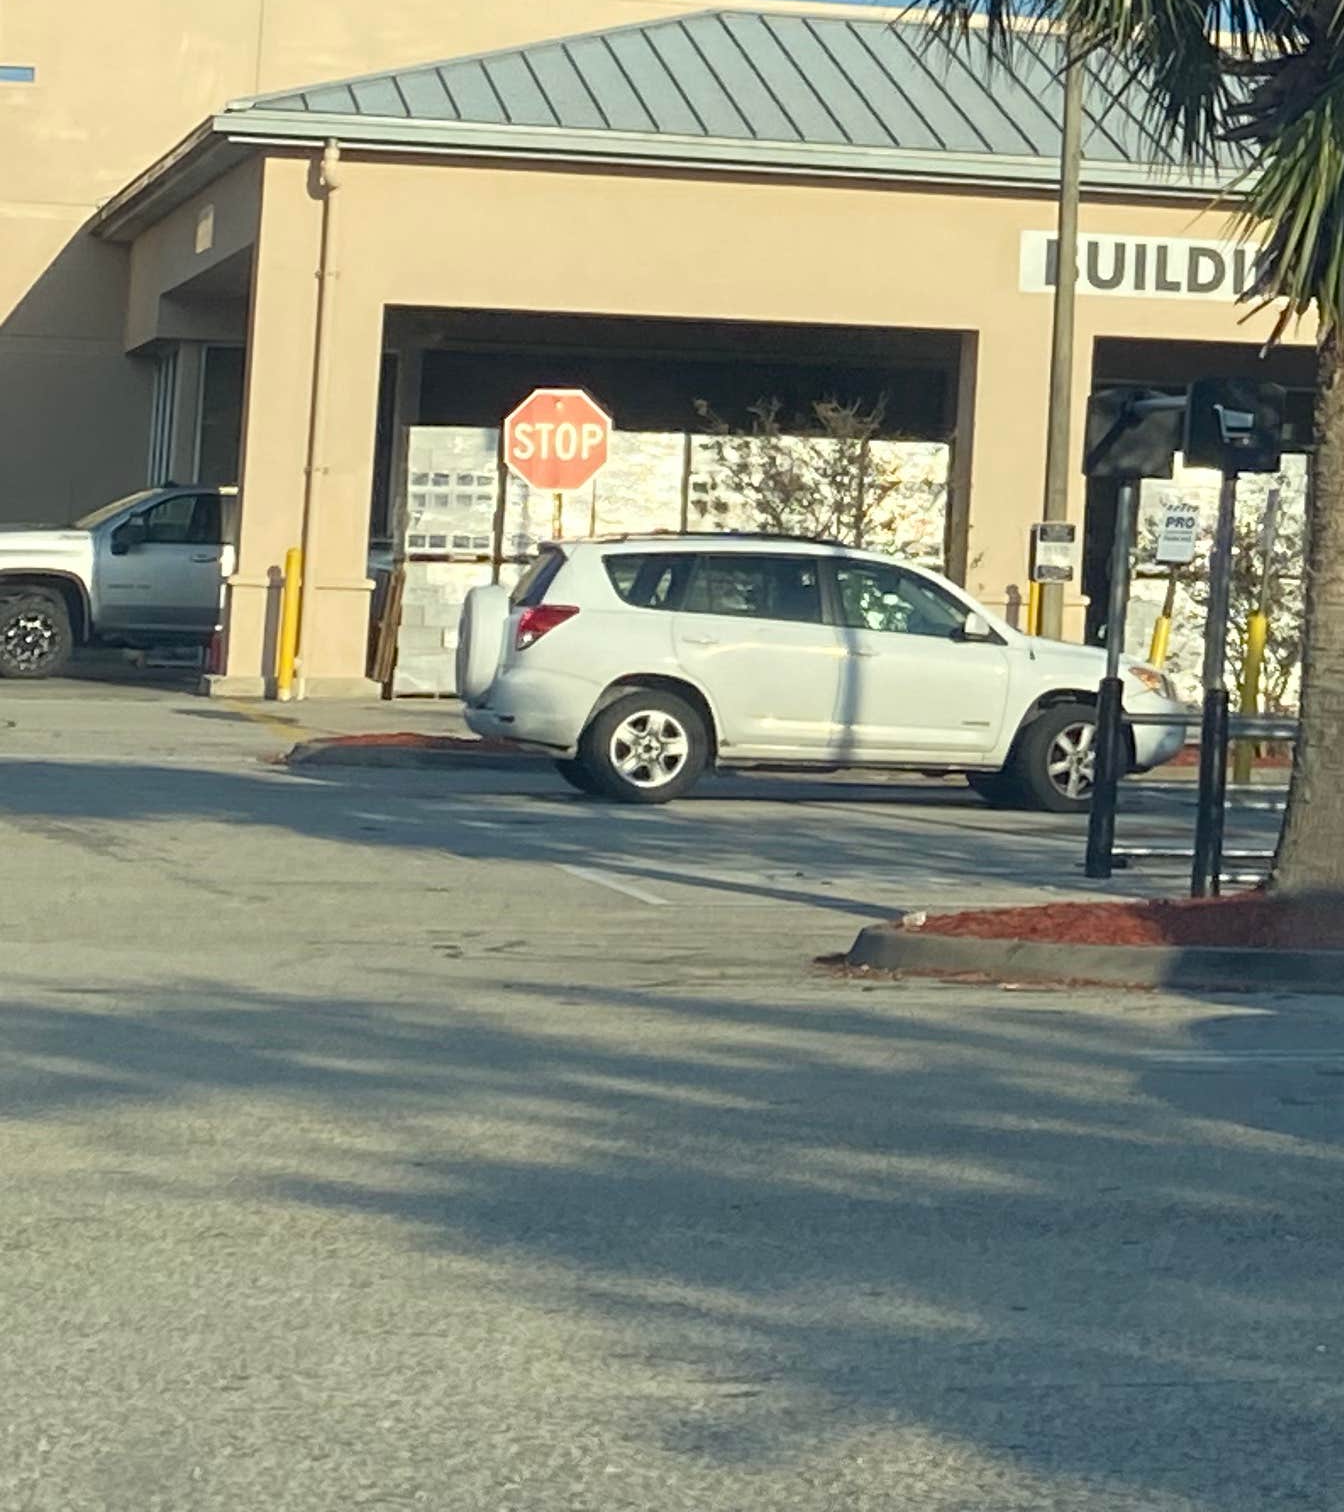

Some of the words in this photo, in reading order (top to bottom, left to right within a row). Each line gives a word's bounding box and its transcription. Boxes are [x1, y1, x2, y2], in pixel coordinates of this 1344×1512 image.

[1045, 238, 1263, 294] UILDI
[512, 422, 604, 461] STOP
[1165, 516, 1195, 529] PRO
